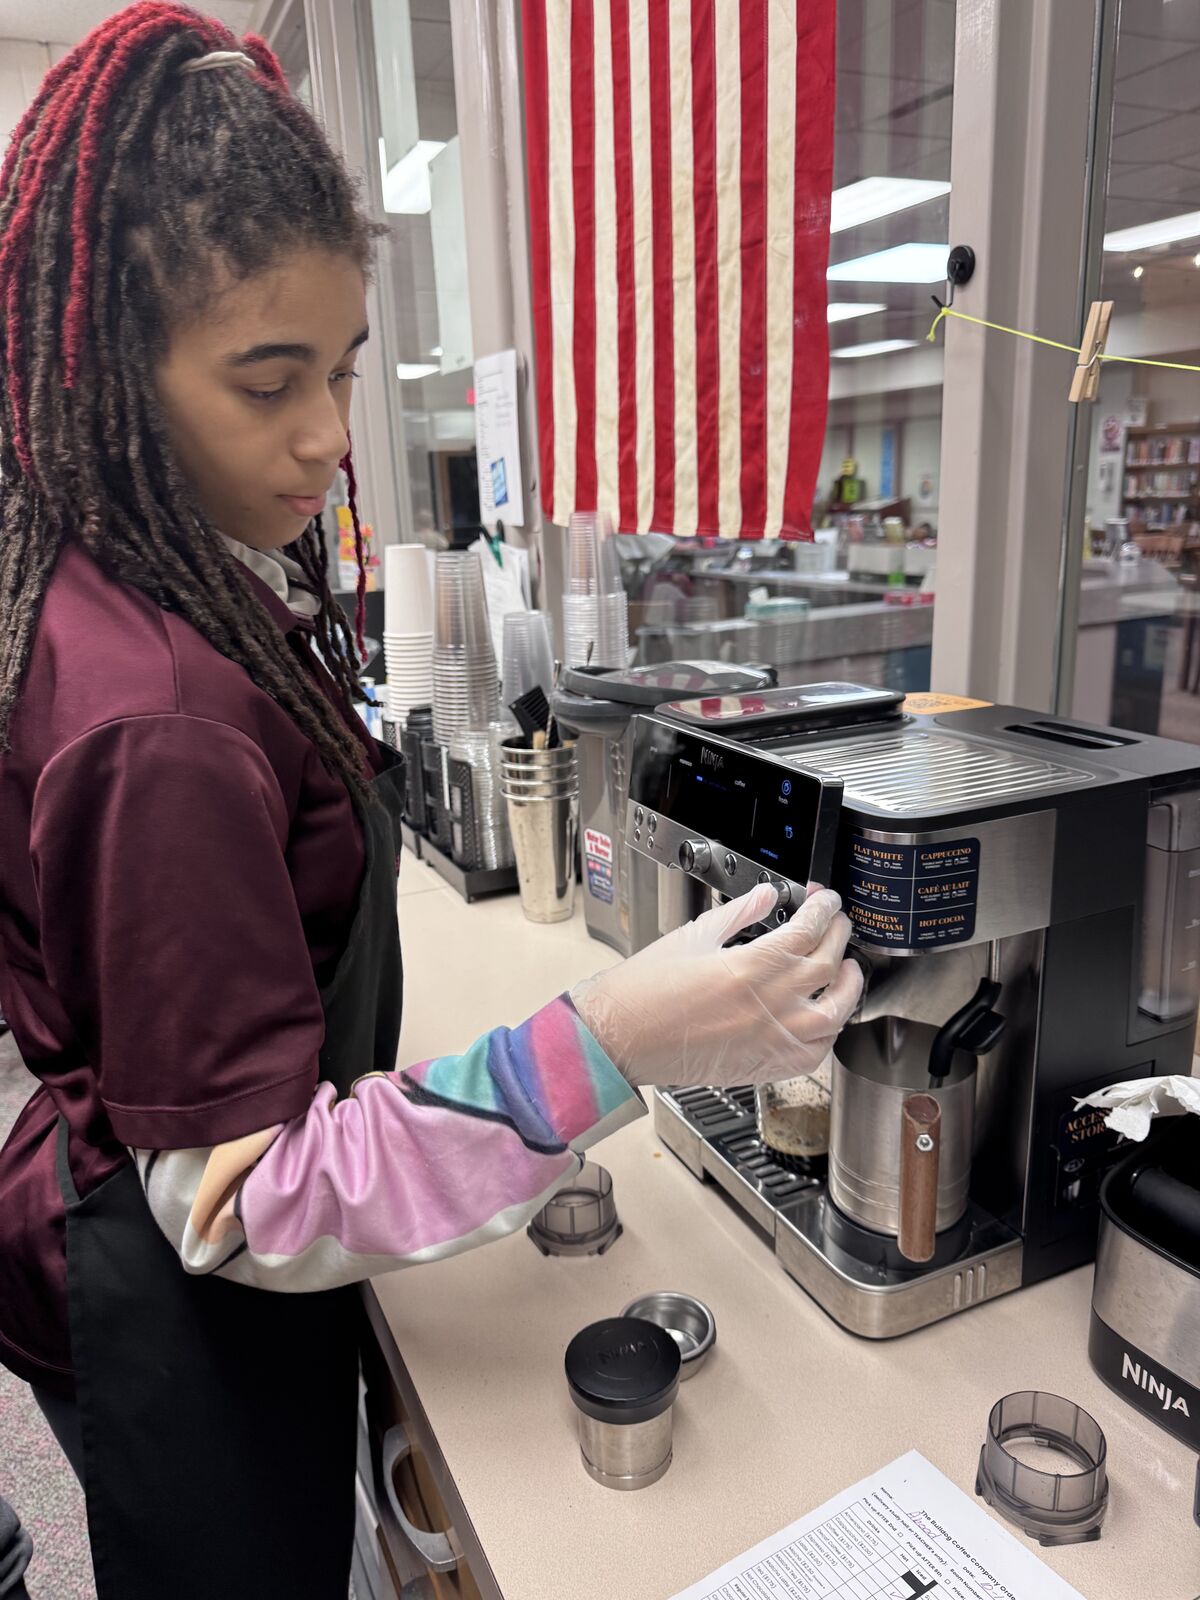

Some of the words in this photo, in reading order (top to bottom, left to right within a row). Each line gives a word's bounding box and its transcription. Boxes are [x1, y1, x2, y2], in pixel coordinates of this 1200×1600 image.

[700, 746, 725, 772] NINJA
[853, 844, 871, 855] FLAT
[872, 850, 904, 861] WHITE
[920, 847, 972, 861] CAPPUCCINO
[861, 880, 888, 893] LATTE
[941, 883, 951, 892] AU
[952, 880, 971, 890] LAIT
[848, 911, 854, 919] &
[855, 914, 875, 926] COLD
[876, 921, 903, 931] FOAM
[851, 905, 871, 918] COLD
[872, 913, 899, 923] BREW
[919, 918, 938, 928] HOT
[938, 914, 965, 925] COCOA
[1121, 1352, 1190, 1417] NINJA
[844, 1511, 866, 1534] Americano
[862, 1497, 871, 1507] Pick
[876, 1511, 889, 1523] AFTER
[887, 1522, 897, 1532] 2nd
[888, 1509, 901, 1521] study
[900, 1519, 910, 1529] hall
[825, 1522, 839, 1537] Coffee
[834, 1516, 859, 1542] Cappuccino
[866, 1519, 880, 1533] Drinks
[797, 1539, 808, 1552] Latte
[807, 1533, 825, 1553] Espresso
[816, 1528, 830, 1541] Decaf
[827, 1540, 841, 1555] Coffee
[919, 1509, 931, 1521] The
[930, 1519, 952, 1541] Bulldog
[951, 1540, 971, 1558] Coffee
[970, 1557, 1001, 1586] Company
[788, 1546, 802, 1562] Mocha
[899, 1553, 909, 1562] Hot
[906, 1541, 916, 1551] Pick
[920, 1556, 935, 1570] AFTER
[755, 1565, 764, 1575] Tea
[765, 1559, 781, 1577] Matcha
[778, 1575, 790, 1588] Latte
[774, 1553, 791, 1571] Matcha
[788, 1569, 798, 1580] Tea
[915, 1569, 927, 1580] Iced
[949, 1568, 964, 1582] Room
[962, 1566, 975, 1578] Date:
[744, 1571, 754, 1581] Hot
